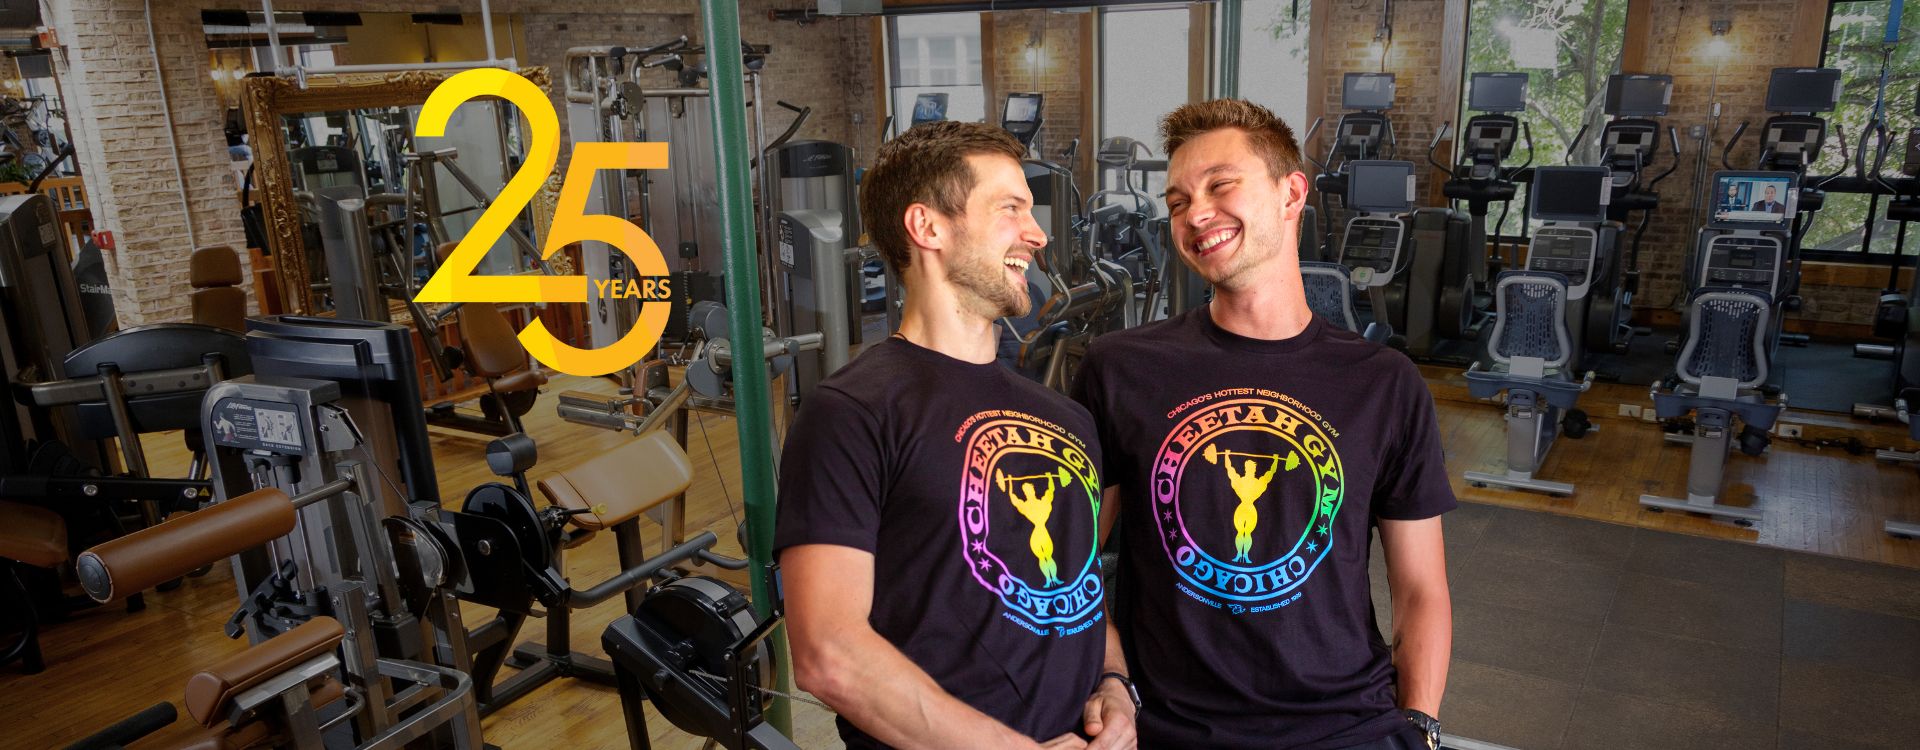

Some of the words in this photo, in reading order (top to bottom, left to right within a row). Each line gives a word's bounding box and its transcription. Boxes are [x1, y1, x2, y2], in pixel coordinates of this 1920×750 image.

[1002, 410, 1066, 434] NEIGHBORHOOD
[1067, 431, 1086, 449] GYM
[1167, 393, 1212, 419] CHICAGO'S
[1213, 388, 1254, 398] HOTTEST
[1256, 389, 1322, 421] NEIGHBORHOOD
[1322, 419, 1340, 438] GYM
[966, 426, 1057, 534] CHEETAH
[1157, 406, 1304, 504] CHEETAH
[1303, 434, 1340, 519] GYM
[1176, 545, 1306, 594] CHICAGO
[998, 573, 1101, 617] CHICAGO
[1250, 598, 1291, 613] ESTABLISHED
